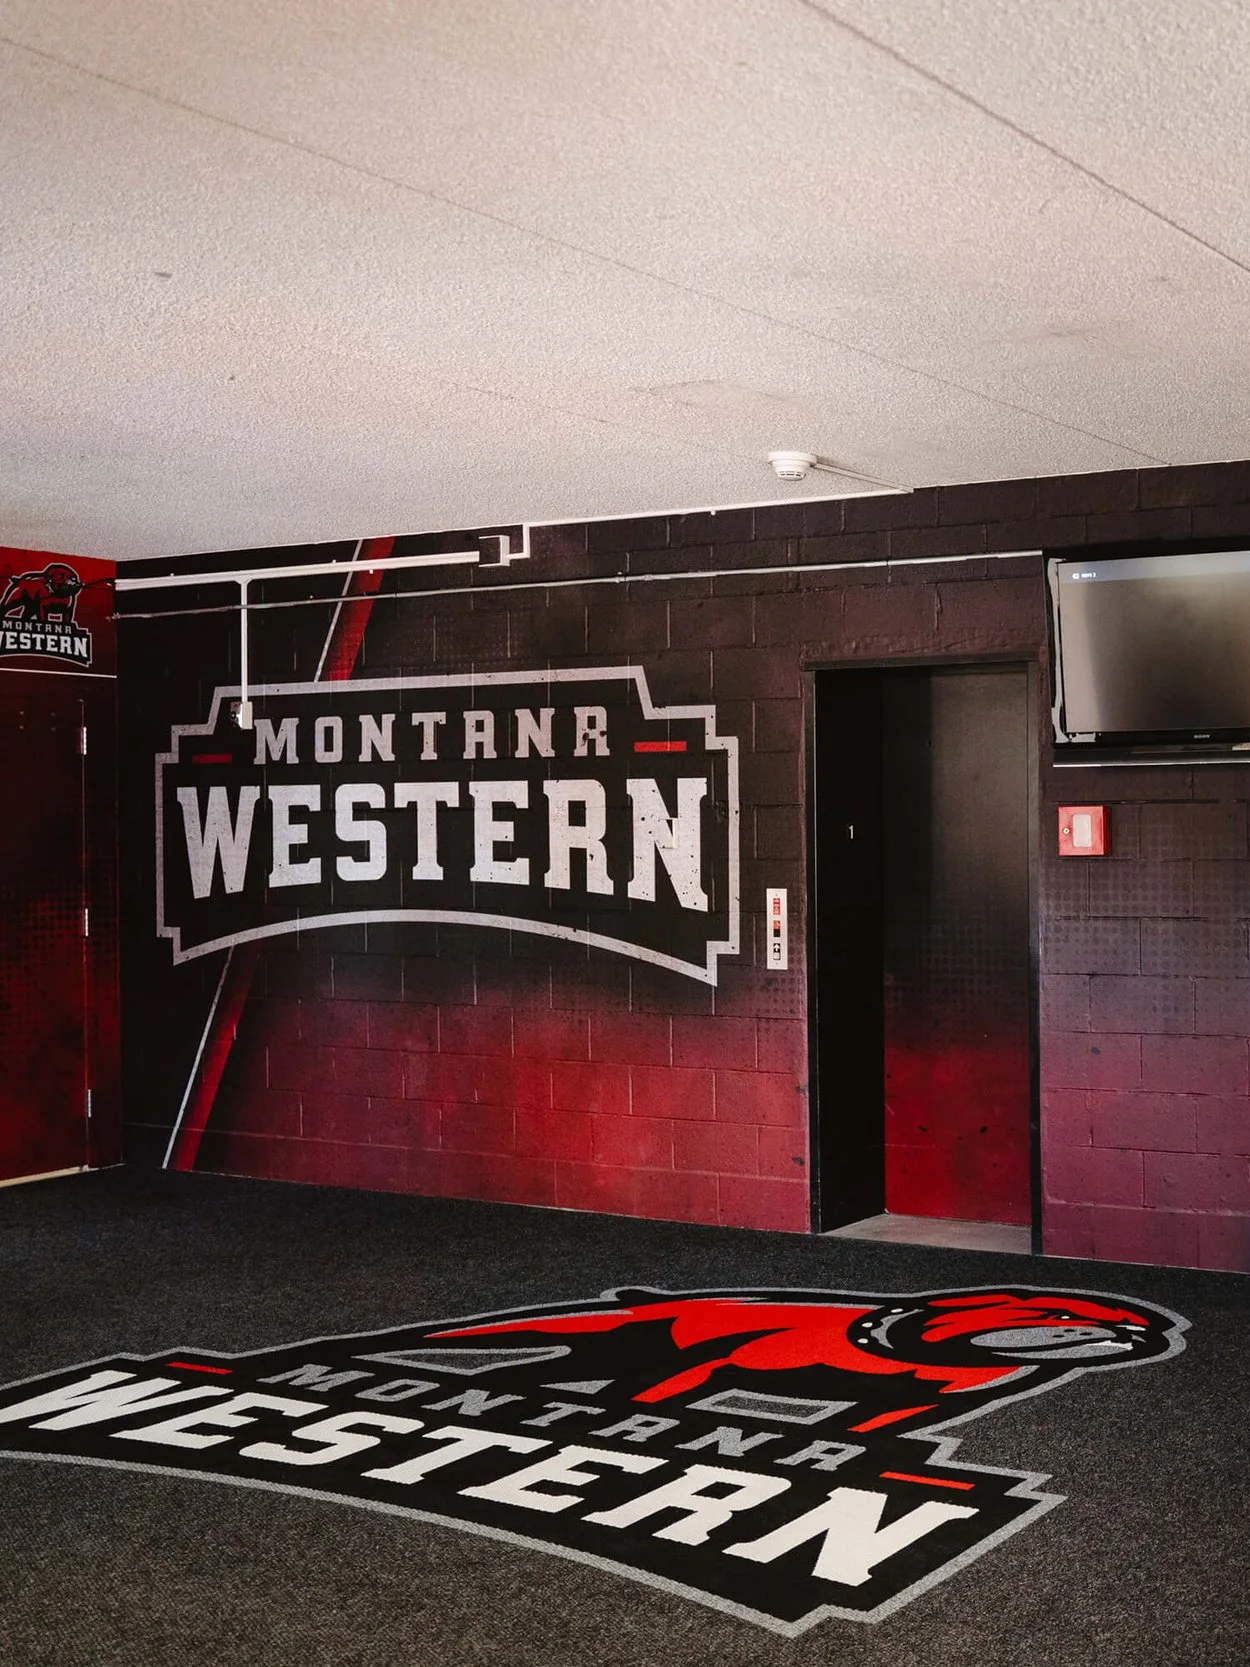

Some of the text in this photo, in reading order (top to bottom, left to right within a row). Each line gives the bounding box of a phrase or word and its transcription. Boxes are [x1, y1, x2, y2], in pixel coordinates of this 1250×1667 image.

[0, 631, 88, 658] ESTERN
[2, 620, 72, 634] MONTANA
[253, 706, 610, 765] MONTANA
[177, 777, 708, 912] WESTERN
[256, 1363, 867, 1471] MONTANA
[0, 1369, 979, 1587] WESTERN
